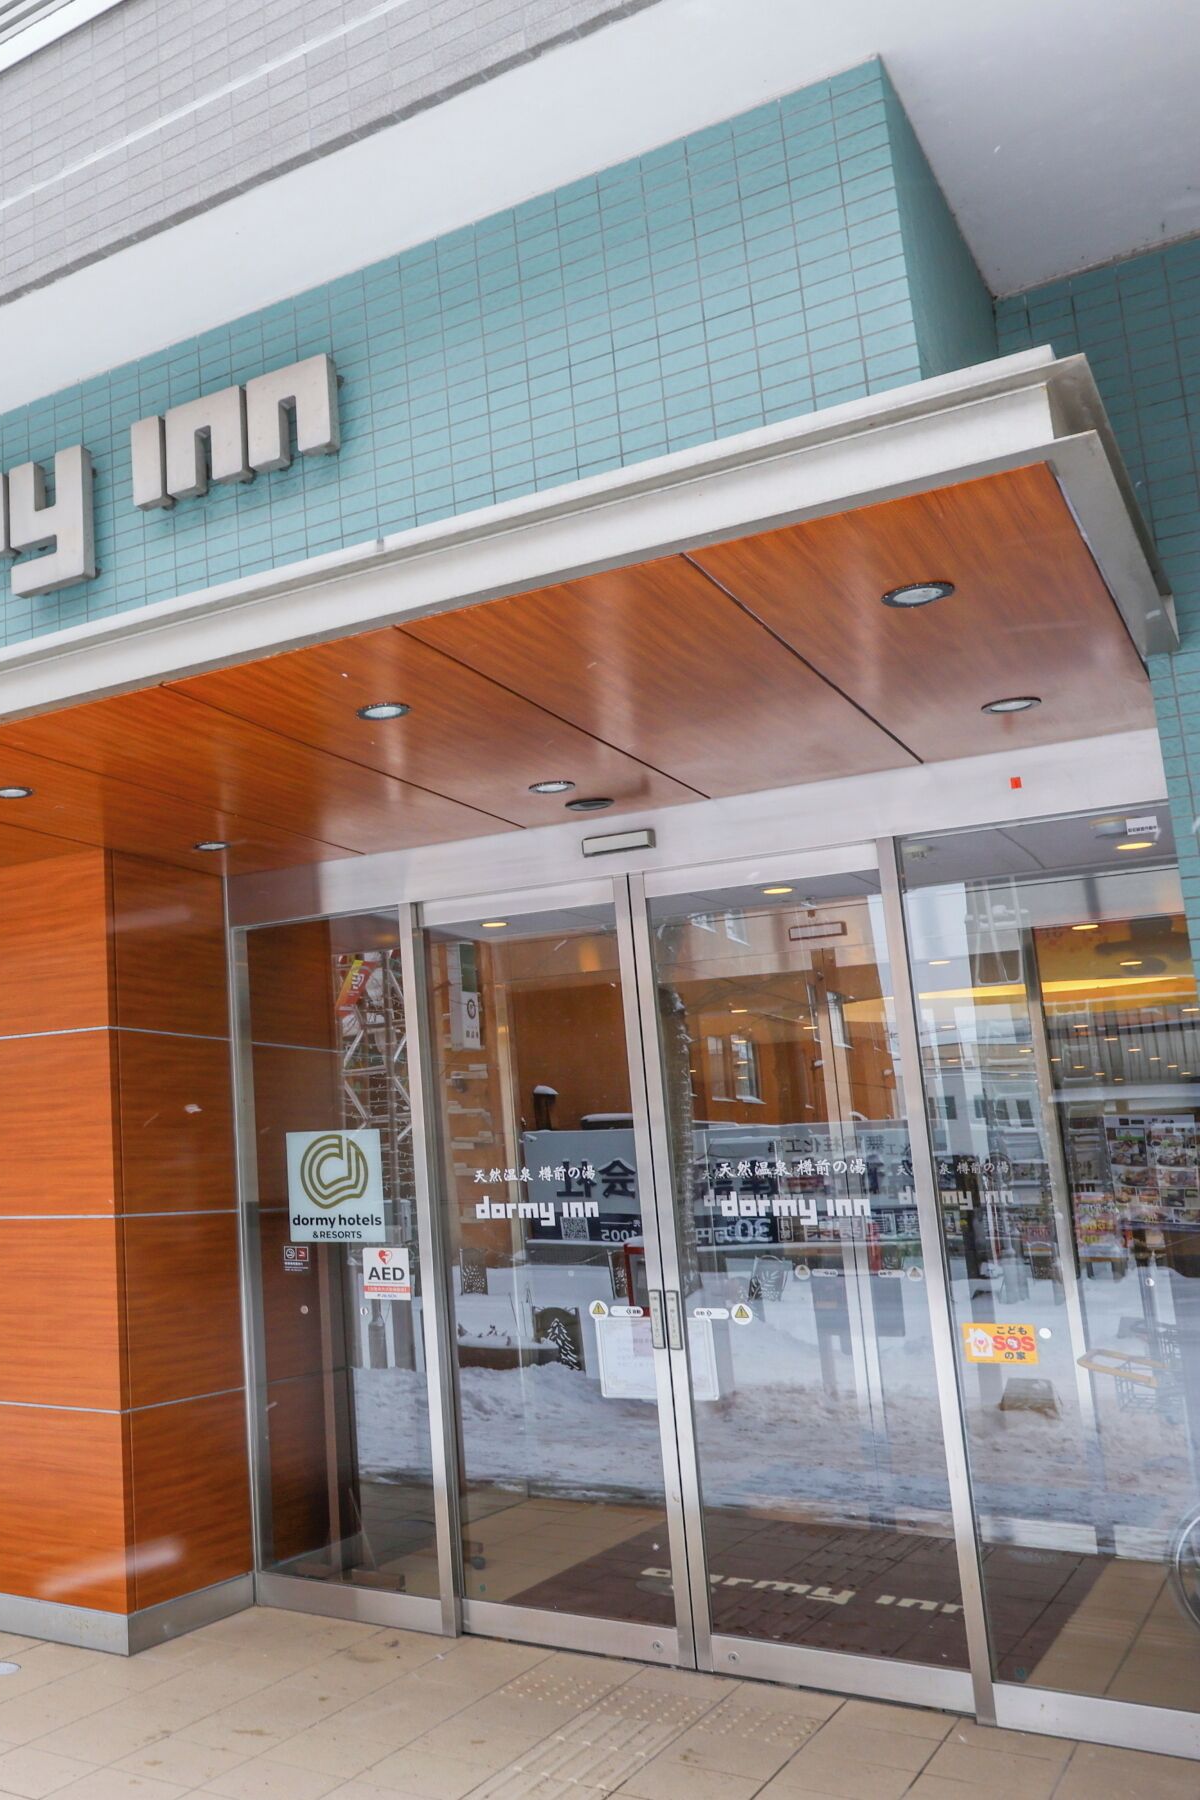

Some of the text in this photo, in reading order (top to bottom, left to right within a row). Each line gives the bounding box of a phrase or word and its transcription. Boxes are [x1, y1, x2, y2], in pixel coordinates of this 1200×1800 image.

[131, 353, 340, 511] inn
[473, 1165, 597, 1184] 天然温泉 樽前の湯
[718, 1160, 791, 1177] 天然温泉
[797, 1159, 867, 1176] 樽前の湯
[475, 1196, 599, 1227] dormy inn
[721, 1191, 818, 1225] dormy
[827, 1198, 871, 1217] inn
[292, 1213, 382, 1229] dormy hotels
[368, 1266, 405, 1281] AED
[996, 1325, 1028, 1336] こども
[992, 1335, 1036, 1351] SOS
